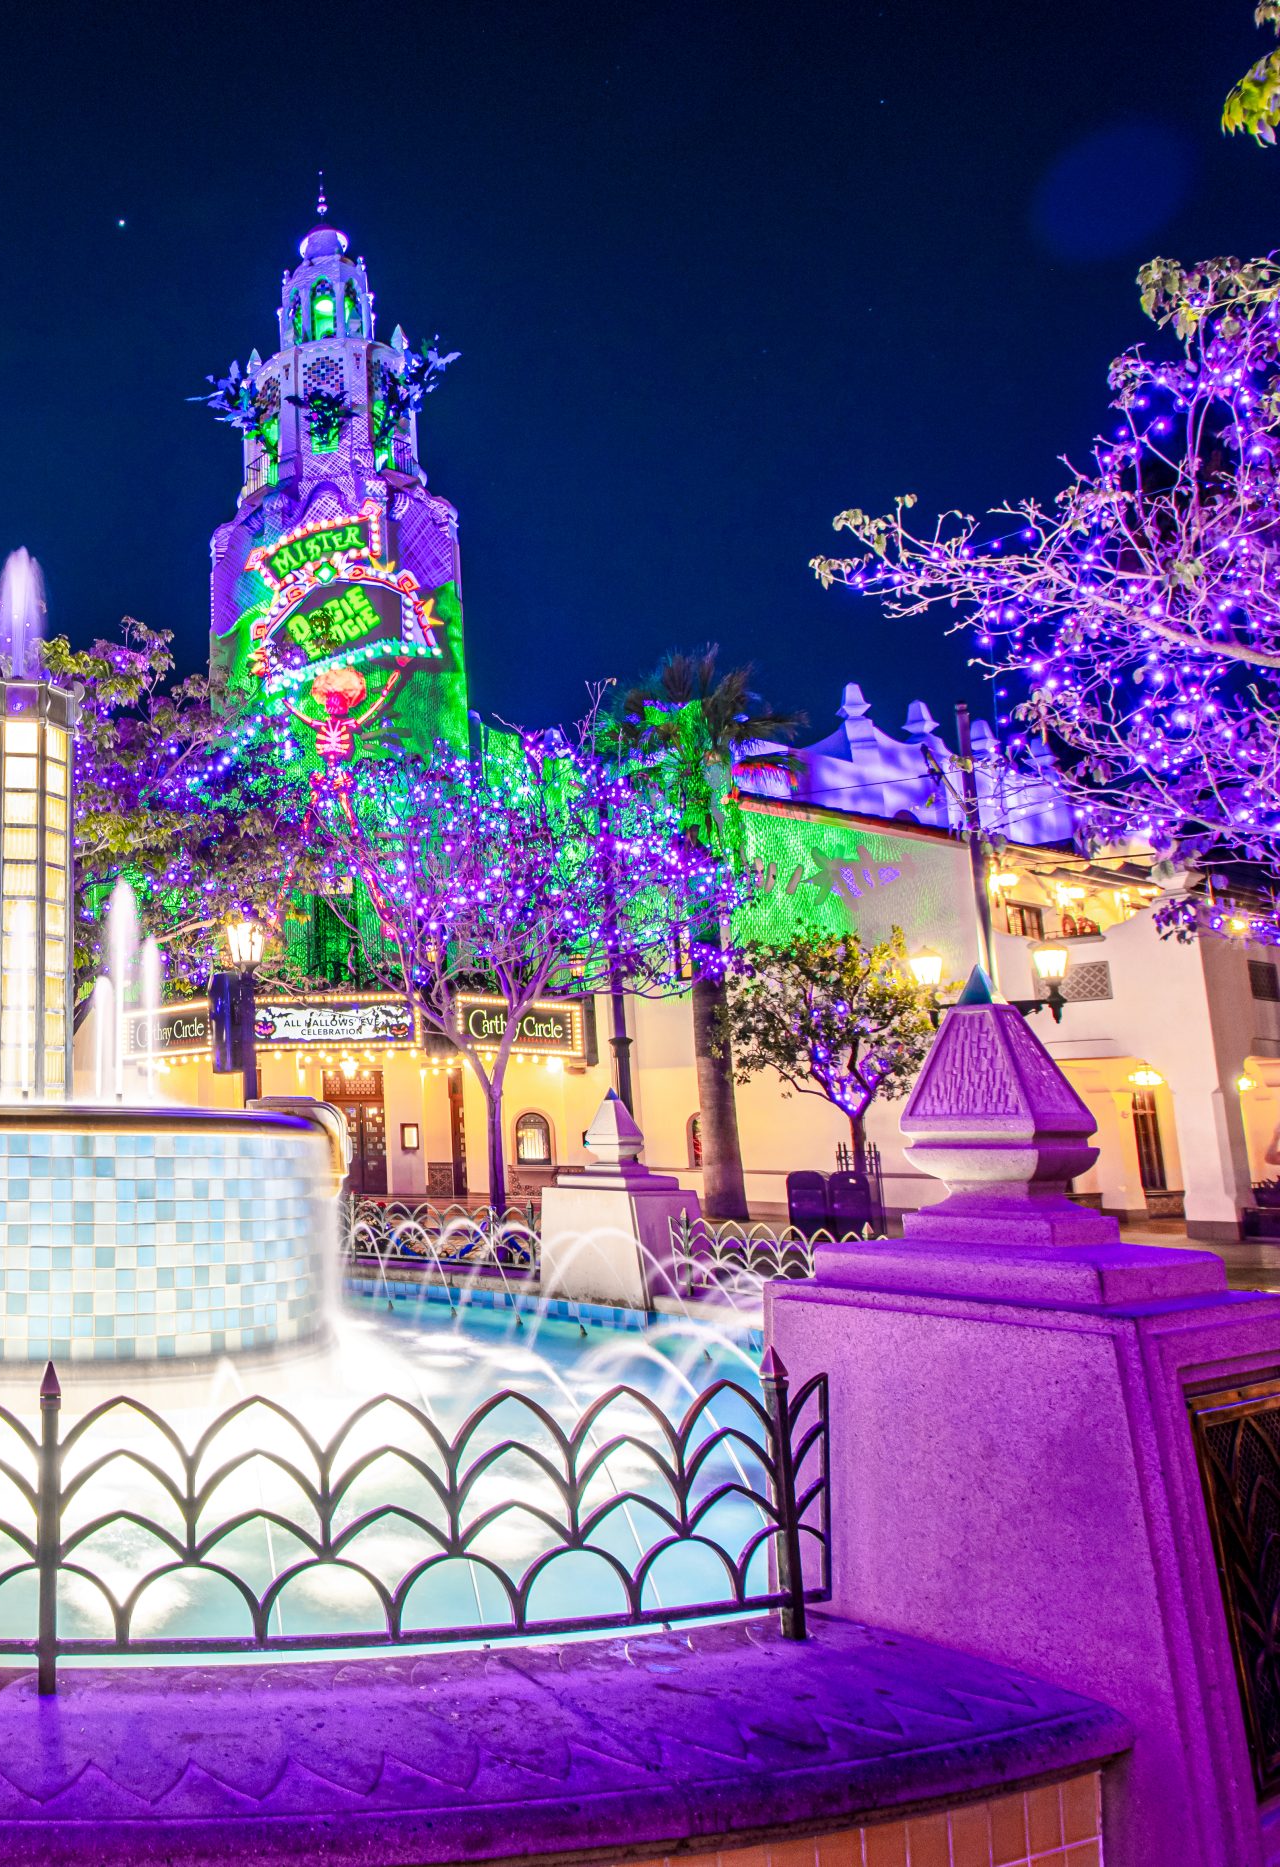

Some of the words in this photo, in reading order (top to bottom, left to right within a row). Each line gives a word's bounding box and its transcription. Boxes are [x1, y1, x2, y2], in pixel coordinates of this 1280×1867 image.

[271, 526, 365, 578] MISTER
[173, 1016, 205, 1039] Circle
[284, 1019, 302, 1028] ALL
[300, 1028, 363, 1037] CELEBRATION
[468, 1009, 522, 1042] Carthy
[523, 1016, 564, 1039] Circle
